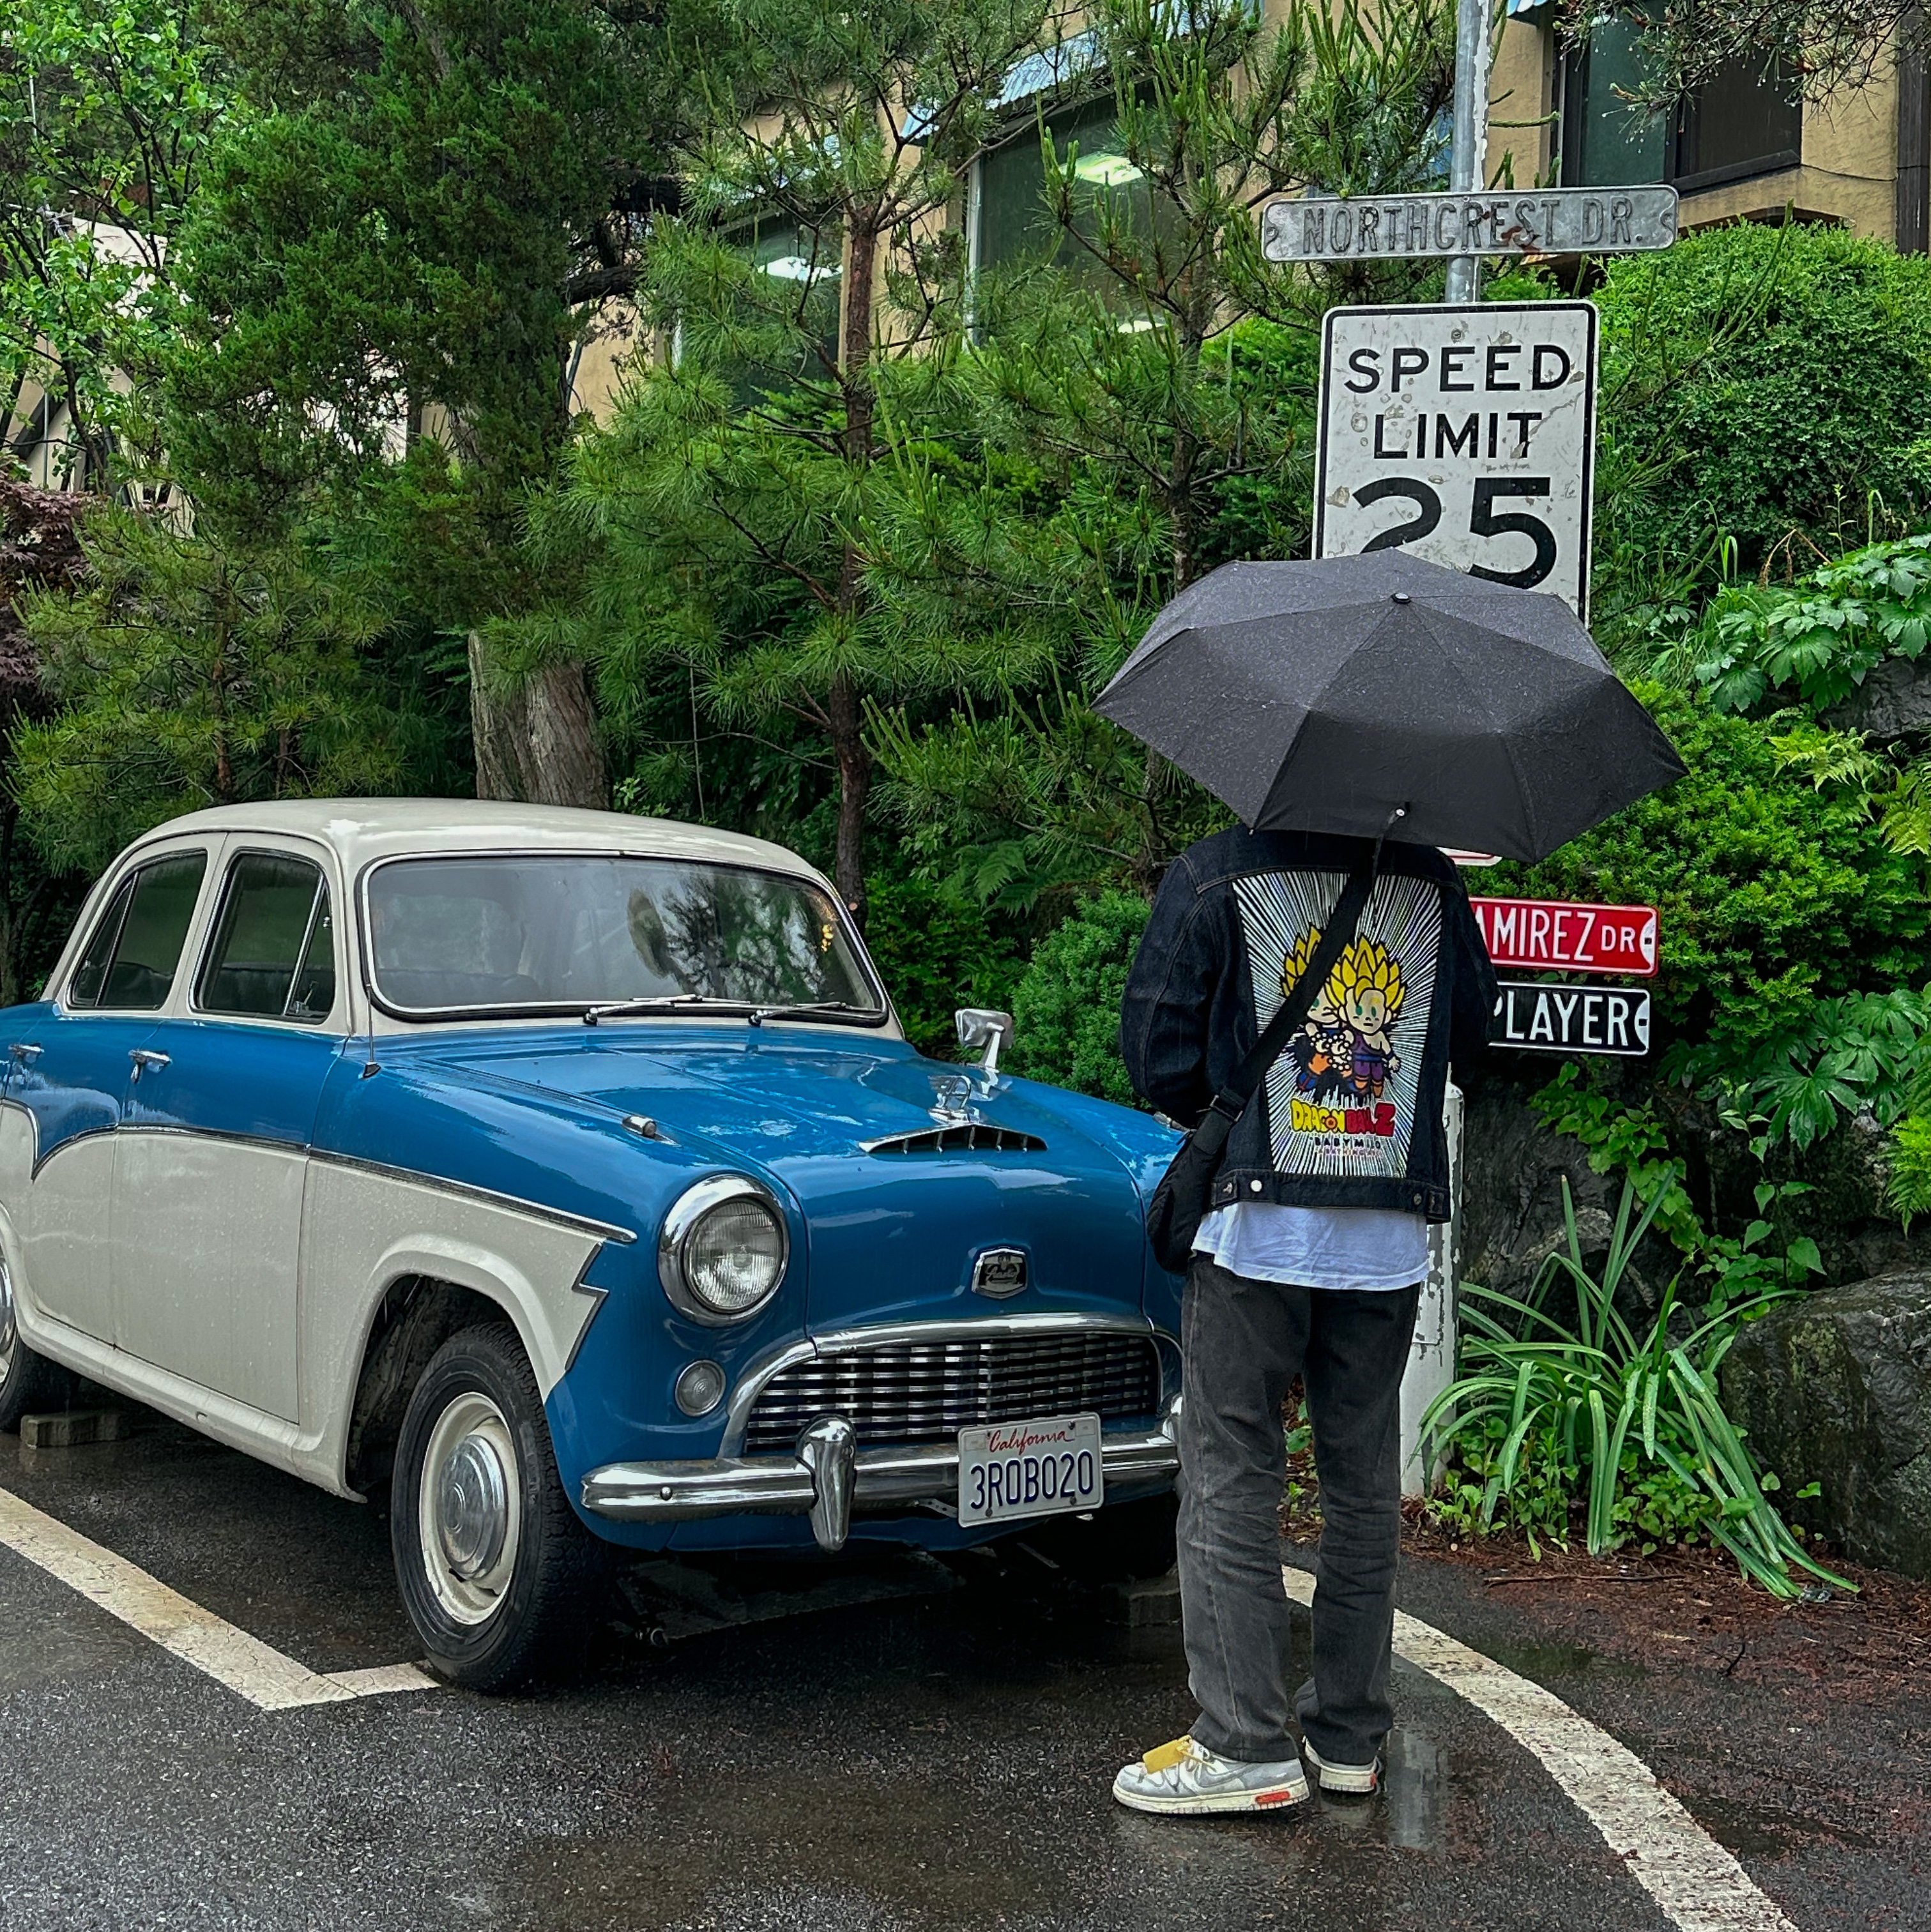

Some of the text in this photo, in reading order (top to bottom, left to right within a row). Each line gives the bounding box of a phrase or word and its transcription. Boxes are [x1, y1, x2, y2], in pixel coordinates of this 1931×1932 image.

[1302, 197, 1644, 254] NORTHCREST DR.
[1344, 344, 1571, 393] SPEED
[1373, 412, 1543, 460] LIMIT
[1352, 476, 1557, 589] 25
[1601, 925, 1635, 952] DR
[1493, 990, 1629, 1046] LAYER
[1315, 1136, 1350, 1148] BABY
[989, 1426, 1076, 1456] California
